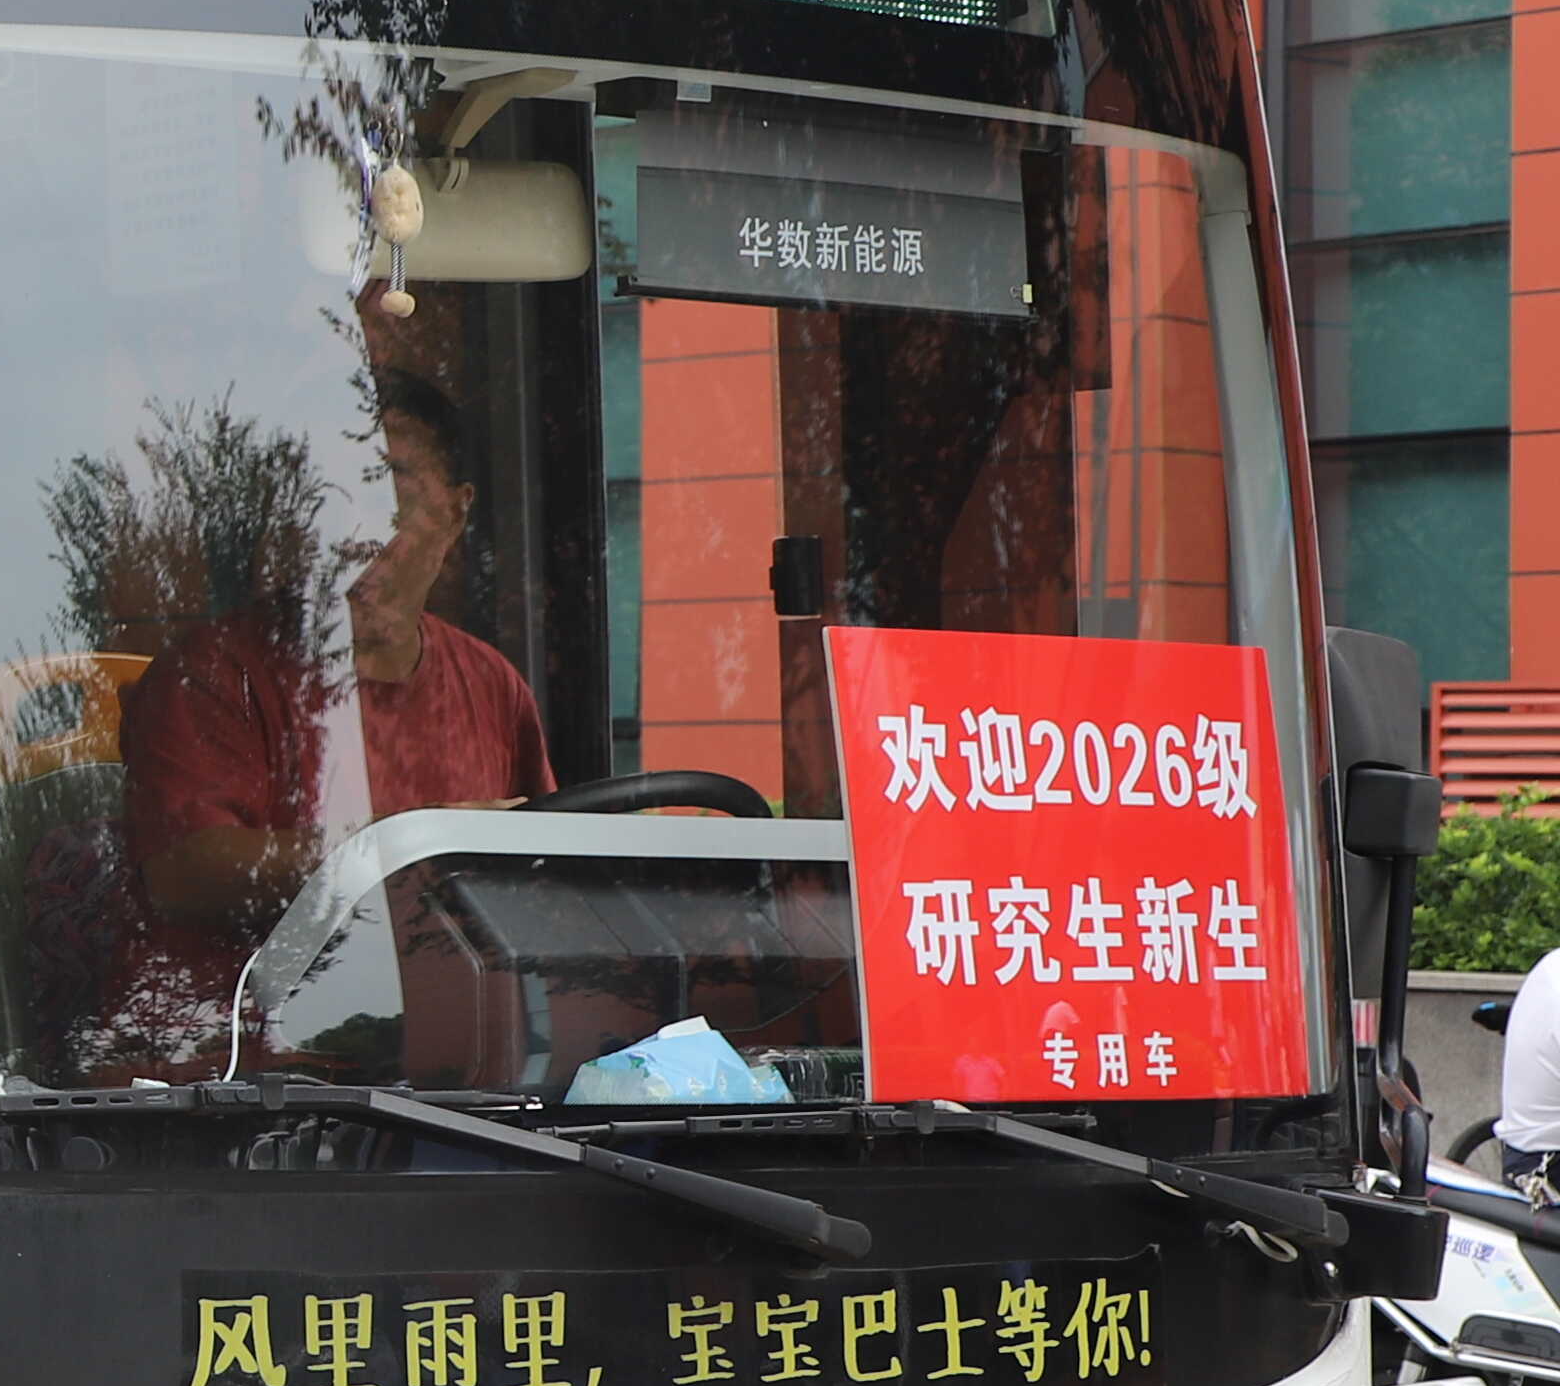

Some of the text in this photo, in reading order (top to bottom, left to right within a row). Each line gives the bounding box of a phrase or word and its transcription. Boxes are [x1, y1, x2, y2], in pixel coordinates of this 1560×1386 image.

[738, 216, 925, 277] 华数新能源
[877, 703, 1258, 820] 欢迎2026级
[902, 876, 1268, 986] 研究生新生
[1041, 1030, 1178, 1089] 专用车
[1446, 1234, 1496, 1264] 巡逻
